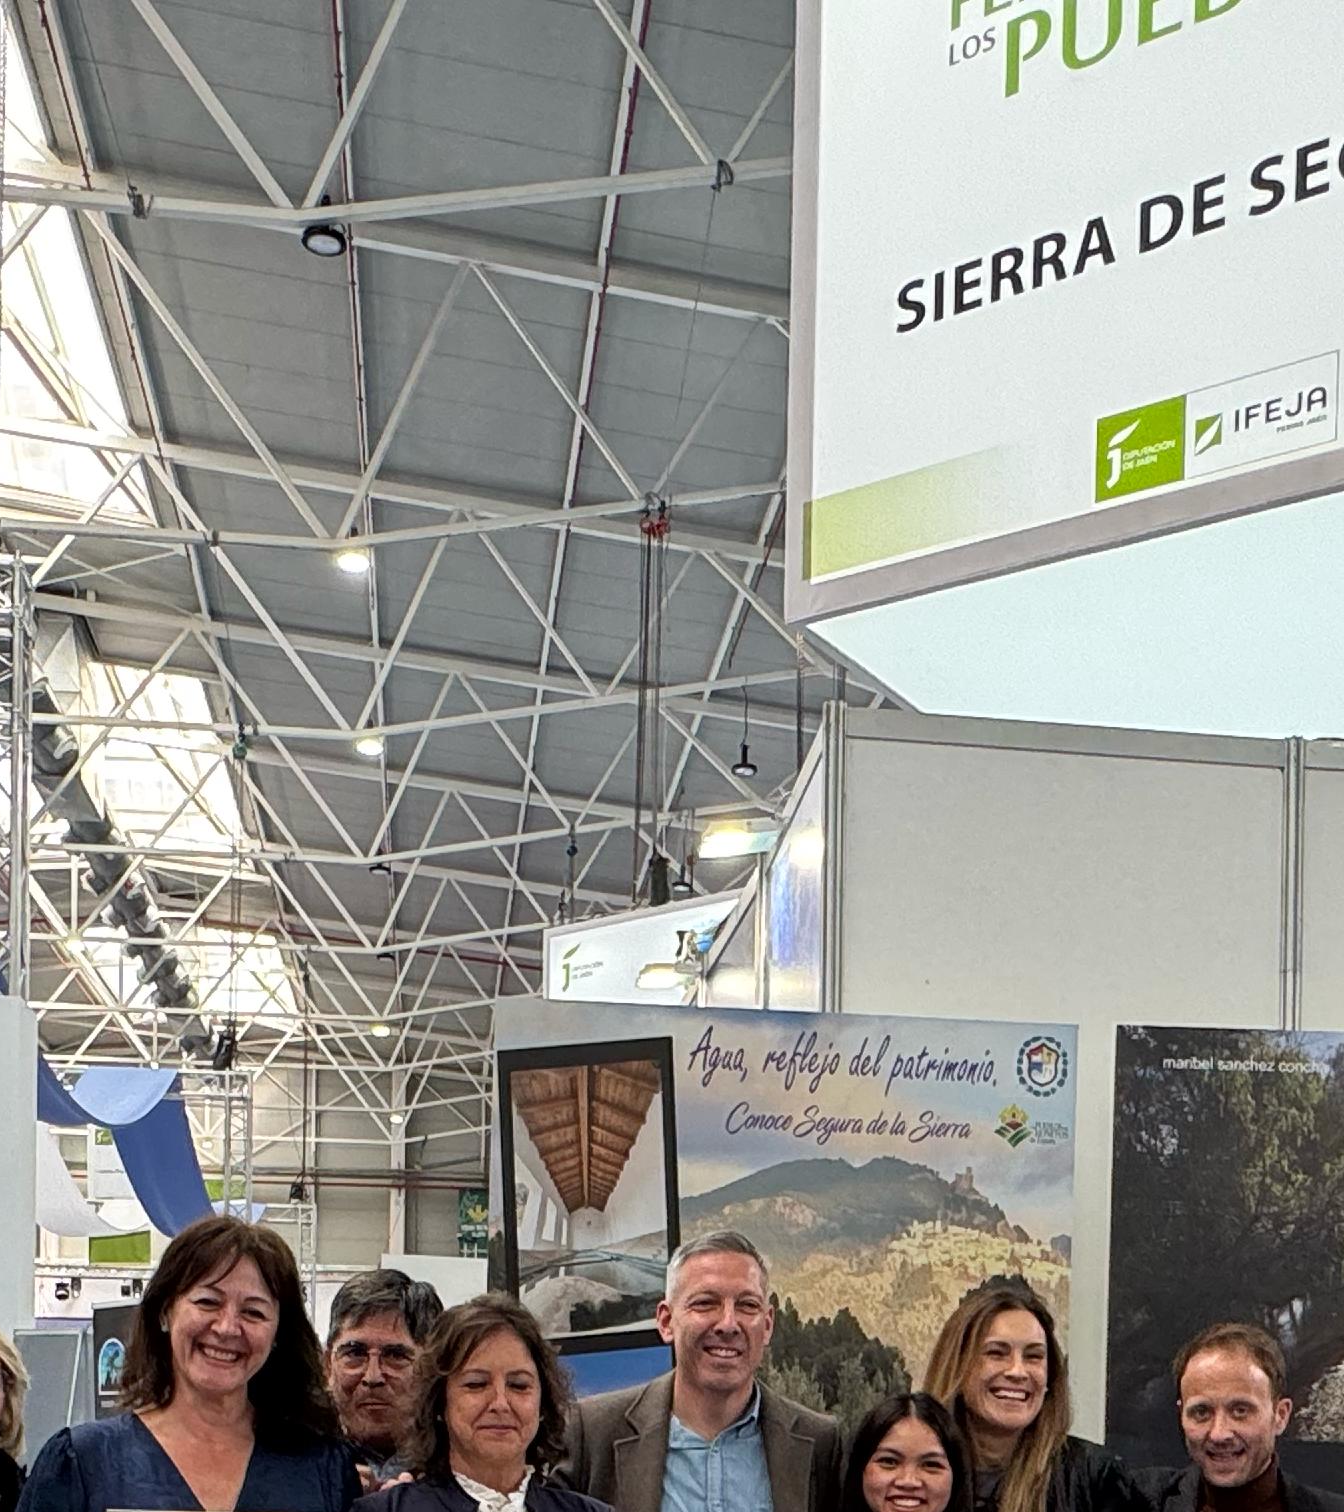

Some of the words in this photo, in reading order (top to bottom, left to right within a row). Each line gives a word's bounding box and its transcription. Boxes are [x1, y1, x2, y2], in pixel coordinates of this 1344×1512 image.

[948, 26, 996, 67] LOS
[896, 216, 1116, 333] SIERRA
[1138, 175, 1226, 254] DE
[1233, 385, 1328, 433] IFEJA
[687, 1025, 748, 1088] Agua,
[761, 1030, 841, 1093] reflejo
[848, 1034, 891, 1079] del
[884, 1047, 998, 1097] patrimonio.
[725, 1100, 794, 1136] Conoce
[793, 1104, 863, 1145] Segura
[866, 1110, 888, 1136] de
[890, 1111, 908, 1136] la
[908, 1110, 972, 1143] Sierra
